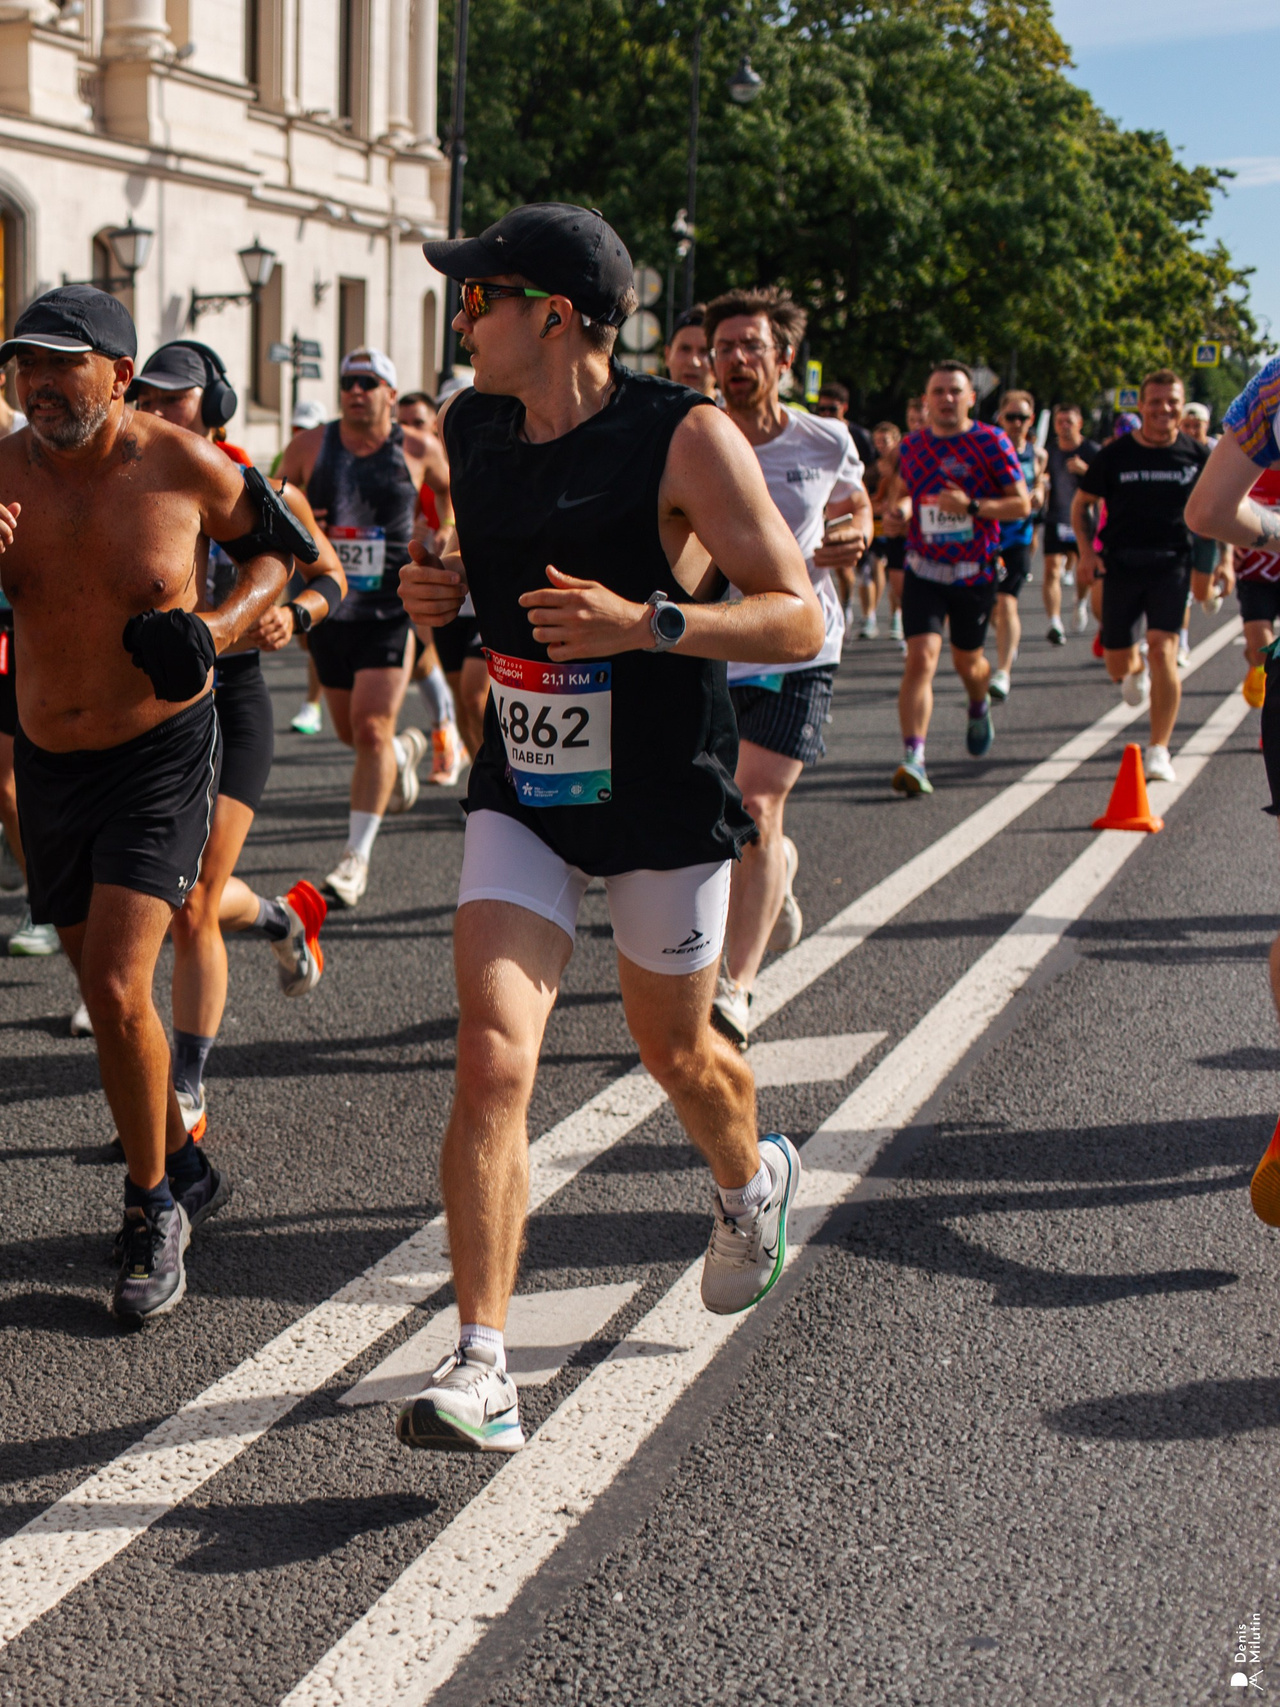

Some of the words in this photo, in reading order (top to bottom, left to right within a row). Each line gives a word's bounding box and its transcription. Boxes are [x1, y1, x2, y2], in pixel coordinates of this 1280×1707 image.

[334, 544, 374, 566] 521
[542, 672, 564, 686] 21,1
[498, 696, 590, 749] 4862
[512, 747, 554, 766] ПАВЕЛ
[662, 938, 712, 954] DEMIX
